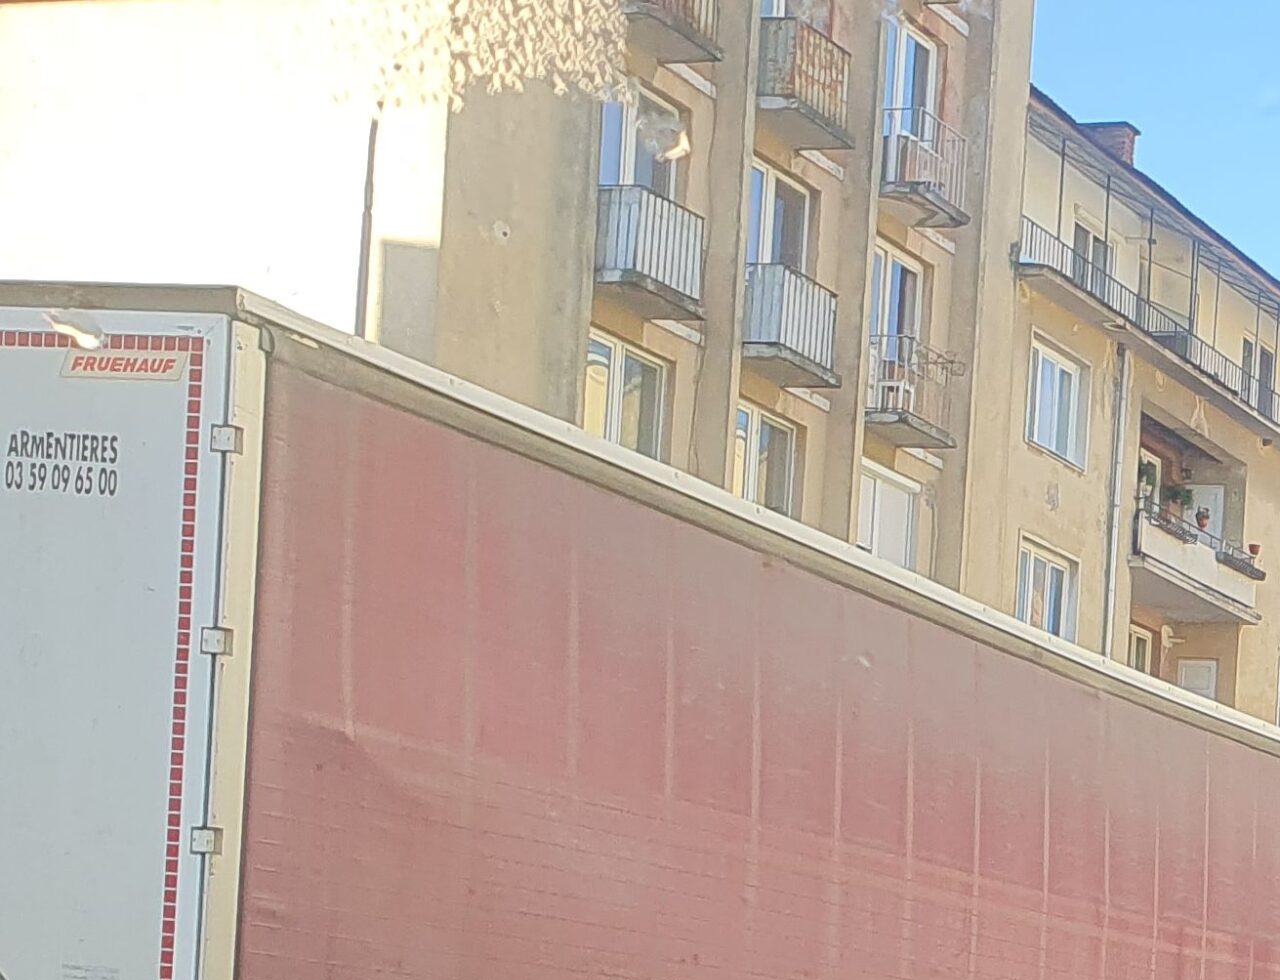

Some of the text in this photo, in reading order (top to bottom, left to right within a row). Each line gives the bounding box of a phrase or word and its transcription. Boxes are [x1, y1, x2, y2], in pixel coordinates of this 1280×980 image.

[71, 356, 177, 374] FRUEHAUF
[7, 430, 119, 464] ARMENTIERES
[5, 461, 118, 496] 03 59 09 65 00
